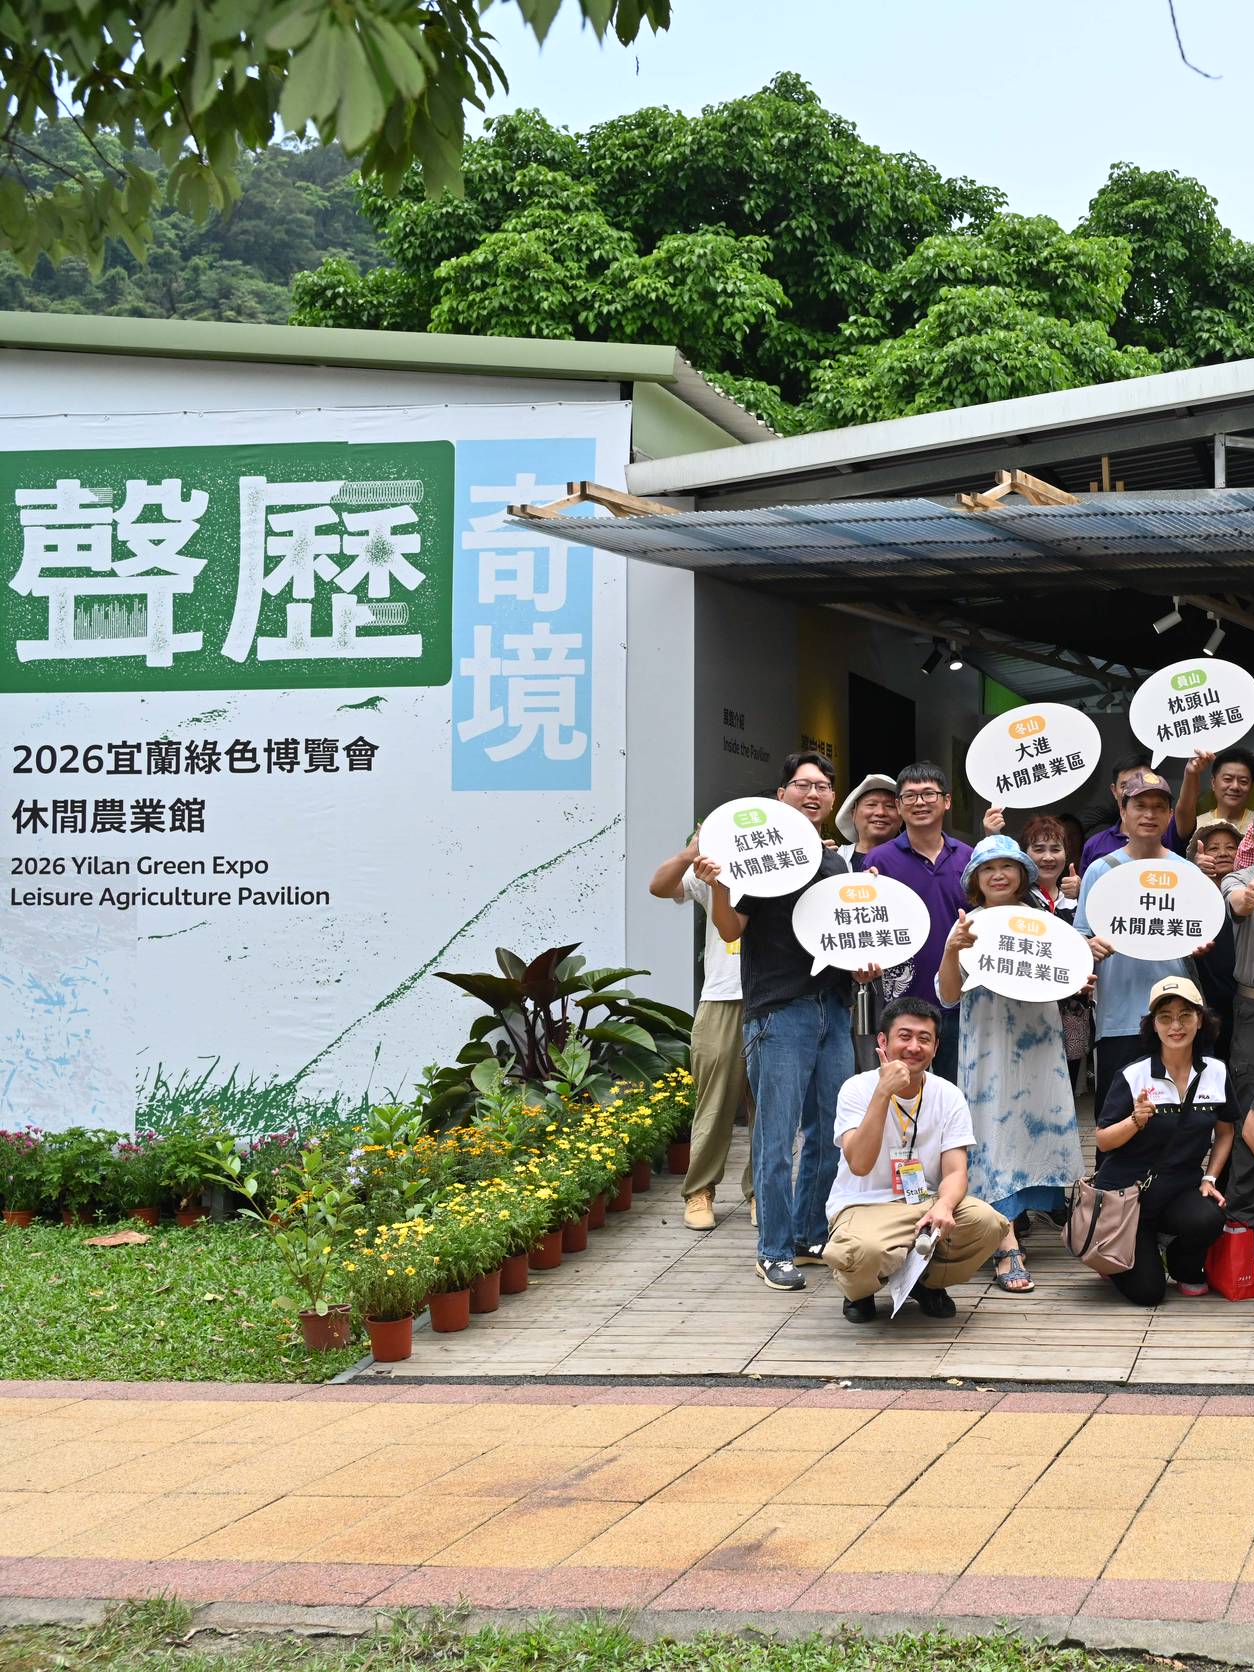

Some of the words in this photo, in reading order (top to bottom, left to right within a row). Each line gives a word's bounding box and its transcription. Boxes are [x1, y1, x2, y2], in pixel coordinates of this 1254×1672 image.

[458, 473, 588, 763] 奇境
[1175, 672, 1206, 689] 員山
[1168, 689, 1220, 714] 枕頭山
[1014, 718, 1043, 736] 冬山
[1157, 706, 1243, 742] 休閒農業區
[13, 736, 379, 775] 2026宜蘭綠色博覽會
[1016, 737, 1052, 762] 大進
[997, 752, 1085, 793] 休閒農業區
[12, 798, 205, 834] 休閒農業館
[735, 828, 783, 852] 紅柴林
[11, 858, 65, 874] 2026
[72, 856, 129, 874] Yilan
[137, 856, 204, 874] Green
[213, 856, 268, 878] Expo
[730, 848, 809, 879] 休閒農業區
[1144, 873, 1174, 889] 冬山
[11, 888, 92, 905] Leisure
[99, 887, 231, 910] Agriculture
[239, 886, 329, 905] Pavilion
[1140, 894, 1174, 911] 中山
[834, 906, 888, 925] 梅花湖
[1013, 919, 1041, 935] 冬山
[1110, 917, 1202, 936] 休閒農業區
[821, 929, 911, 951] 休閒農業區
[999, 935, 1052, 958] 羅東溪
[978, 955, 1069, 984] 休閒農業區
[906, 1187, 924, 1196] Staff
